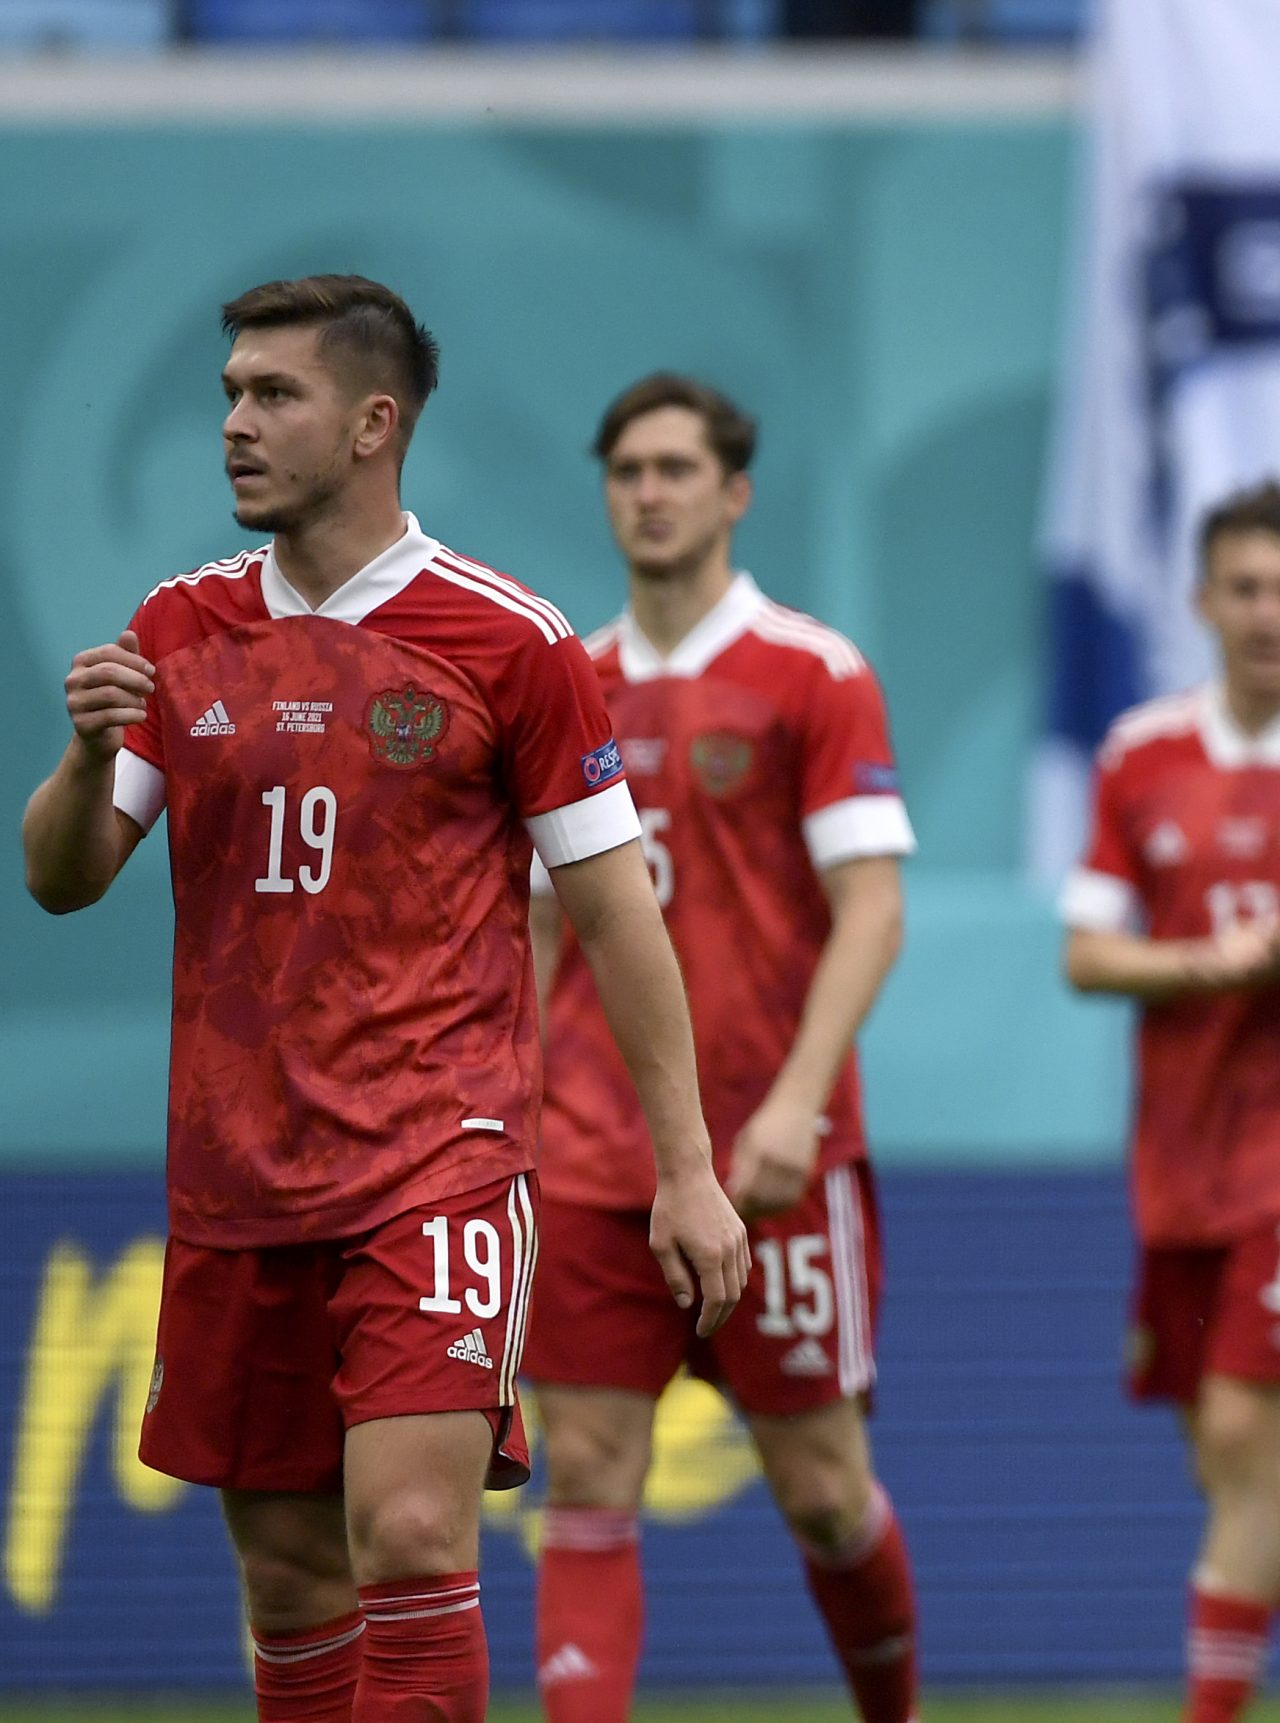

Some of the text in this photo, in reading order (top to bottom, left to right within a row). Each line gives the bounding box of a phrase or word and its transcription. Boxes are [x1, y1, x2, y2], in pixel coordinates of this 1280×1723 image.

[272, 701, 333, 712] FINLAND VS RUSSIA
[281, 711, 322, 722] 16 JUNE 2021
[190, 722, 236, 737] adidas
[286, 722, 325, 733] PETERSBURG
[254, 785, 338, 894] 19
[419, 1215, 501, 1319] 19
[755, 1232, 834, 1338] 15
[447, 1346, 494, 1369] adidas
